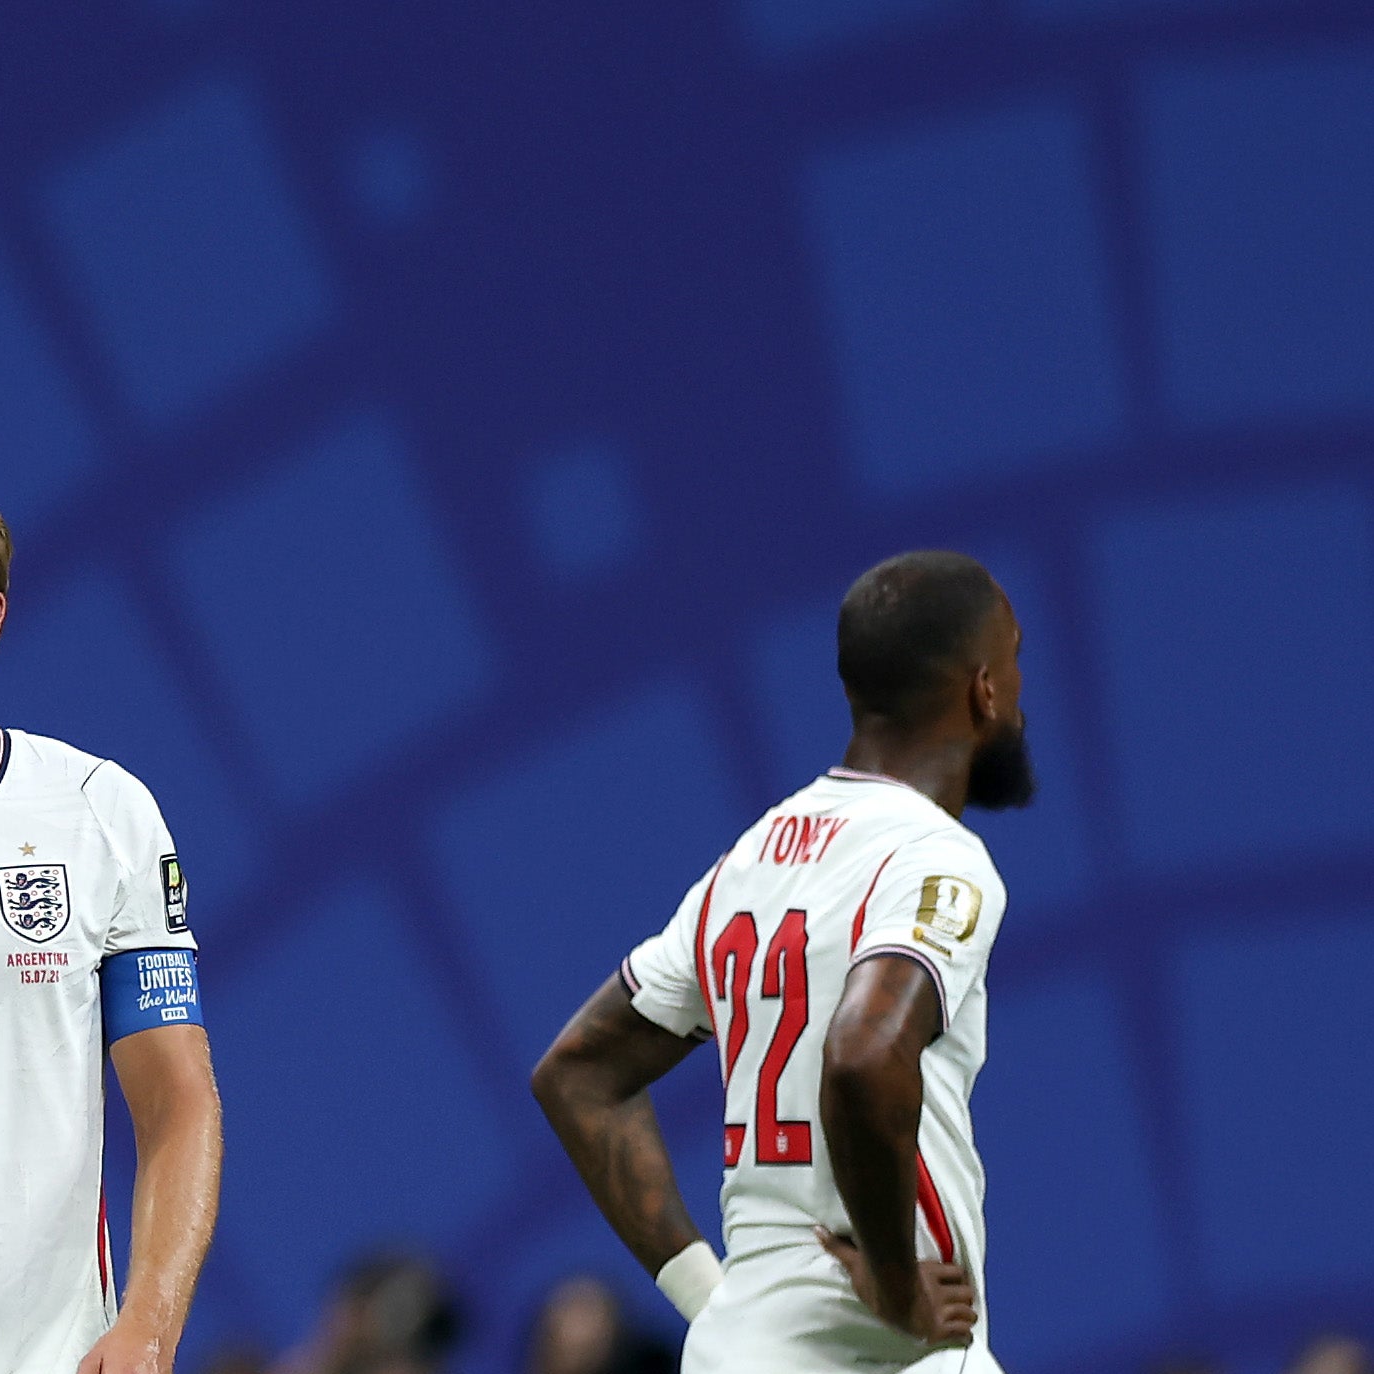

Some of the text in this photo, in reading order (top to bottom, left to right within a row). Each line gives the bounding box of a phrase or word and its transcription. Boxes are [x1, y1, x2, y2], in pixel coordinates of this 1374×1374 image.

[7, 952, 69, 967] ARGENTINA
[137, 952, 190, 971] FOOTBALL
[139, 967, 193, 991] UNITES
[137, 987, 197, 1011] the World
[163, 1009, 186, 1019] FIFA
[712, 909, 812, 1167] 22
